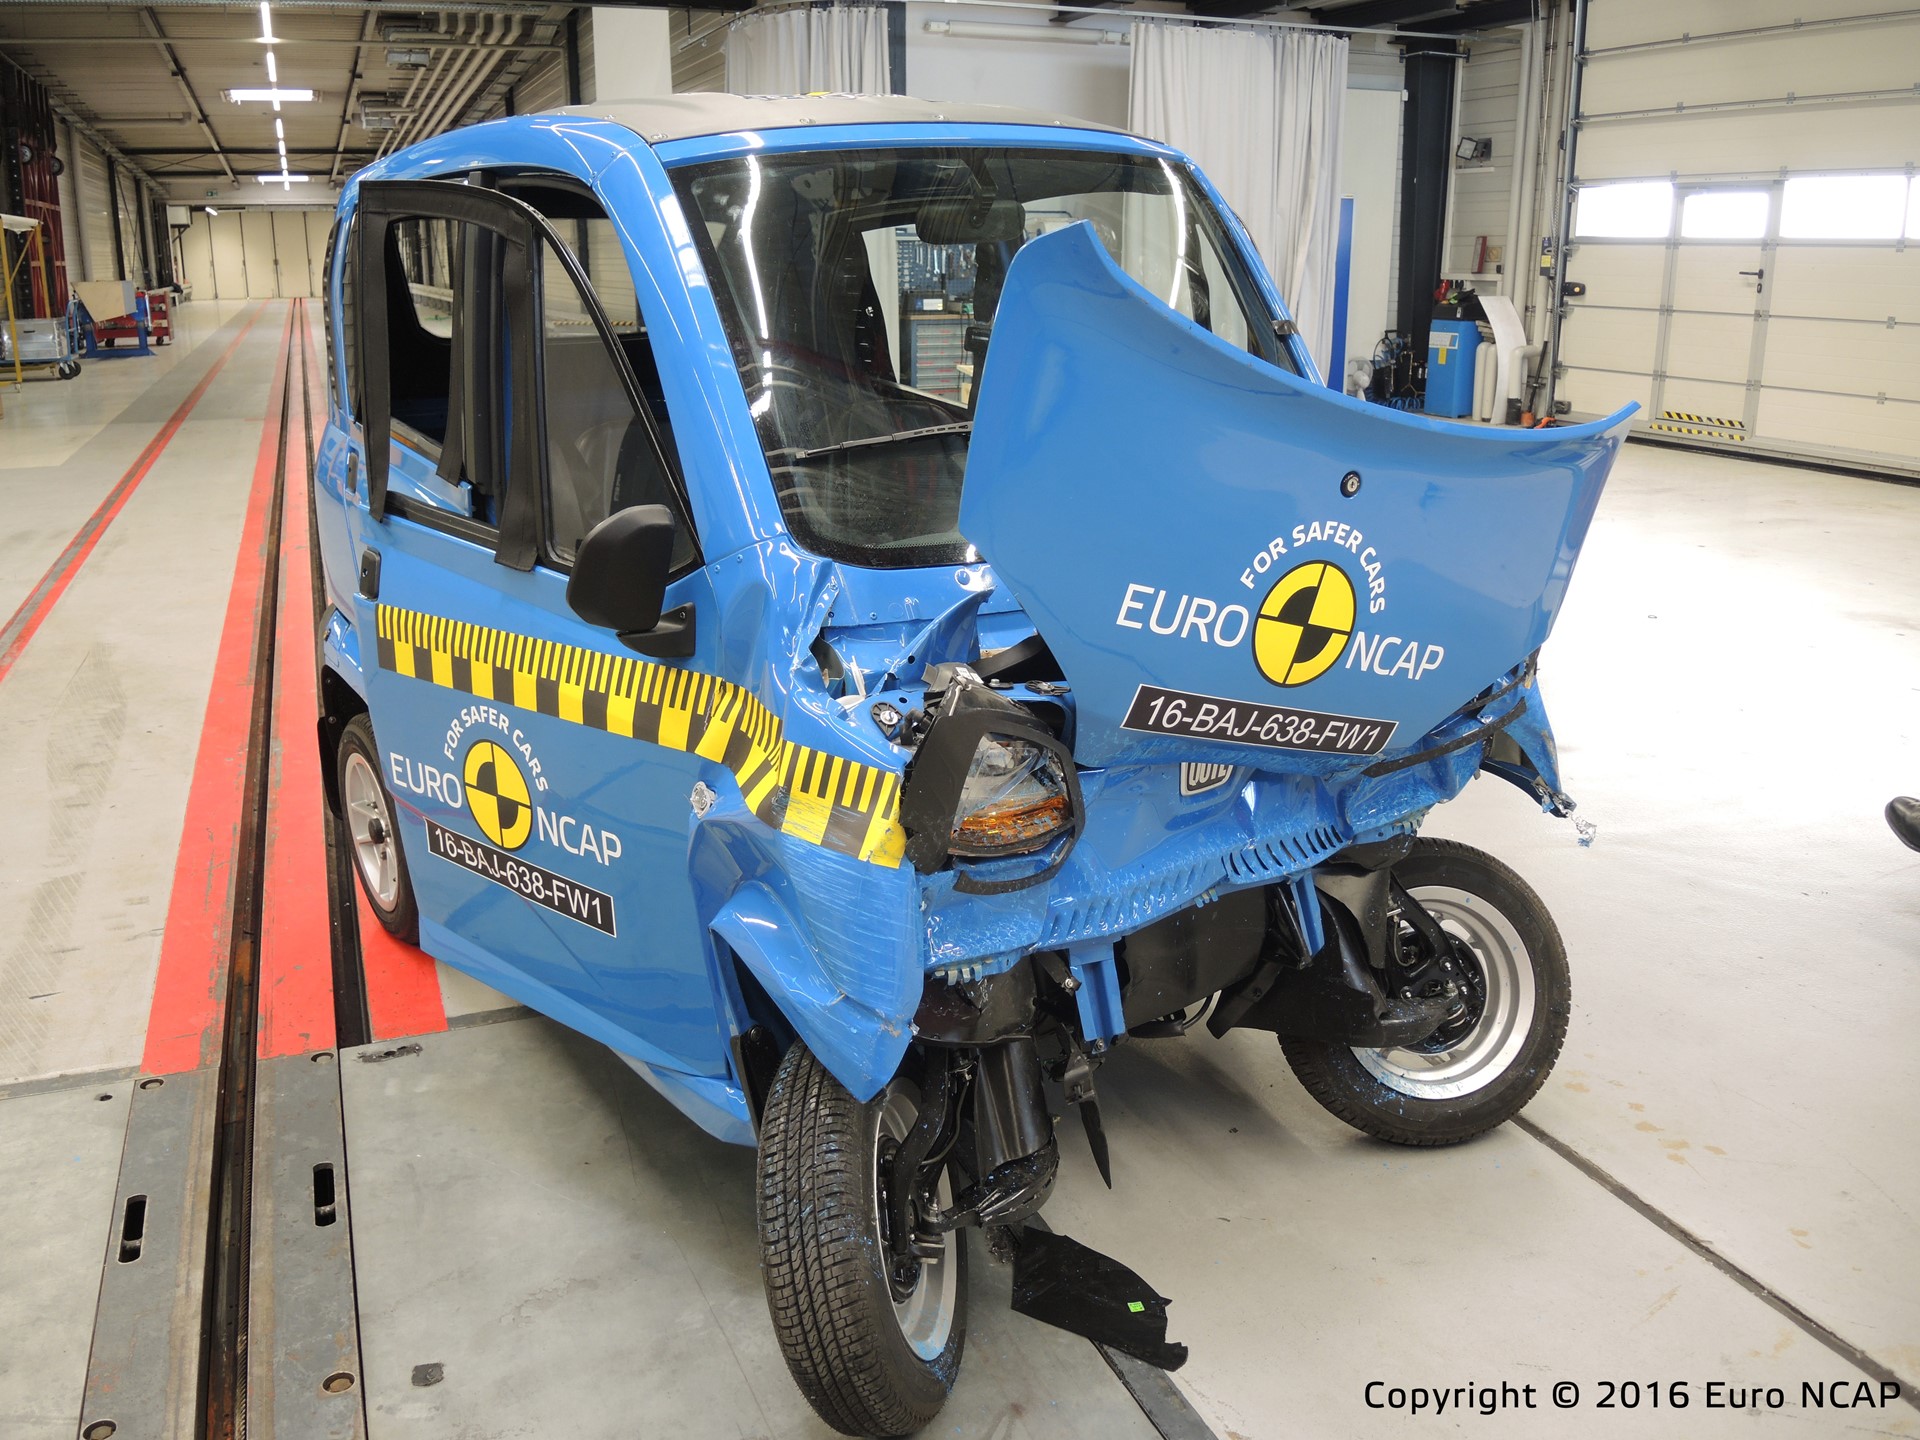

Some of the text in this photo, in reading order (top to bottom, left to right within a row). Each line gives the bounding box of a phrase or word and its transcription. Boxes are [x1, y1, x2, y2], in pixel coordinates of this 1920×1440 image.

[1240, 520, 1386, 614] FOR SAFER CARS
[1115, 582, 1445, 681] EURO NCAP
[443, 705, 549, 792] FOR SAFER CARS
[1147, 696, 1381, 752] 16-BAJ-638-FW1
[389, 752, 622, 867] EURO NCAP
[435, 827, 603, 925] 16-BAJ-638-FW1
